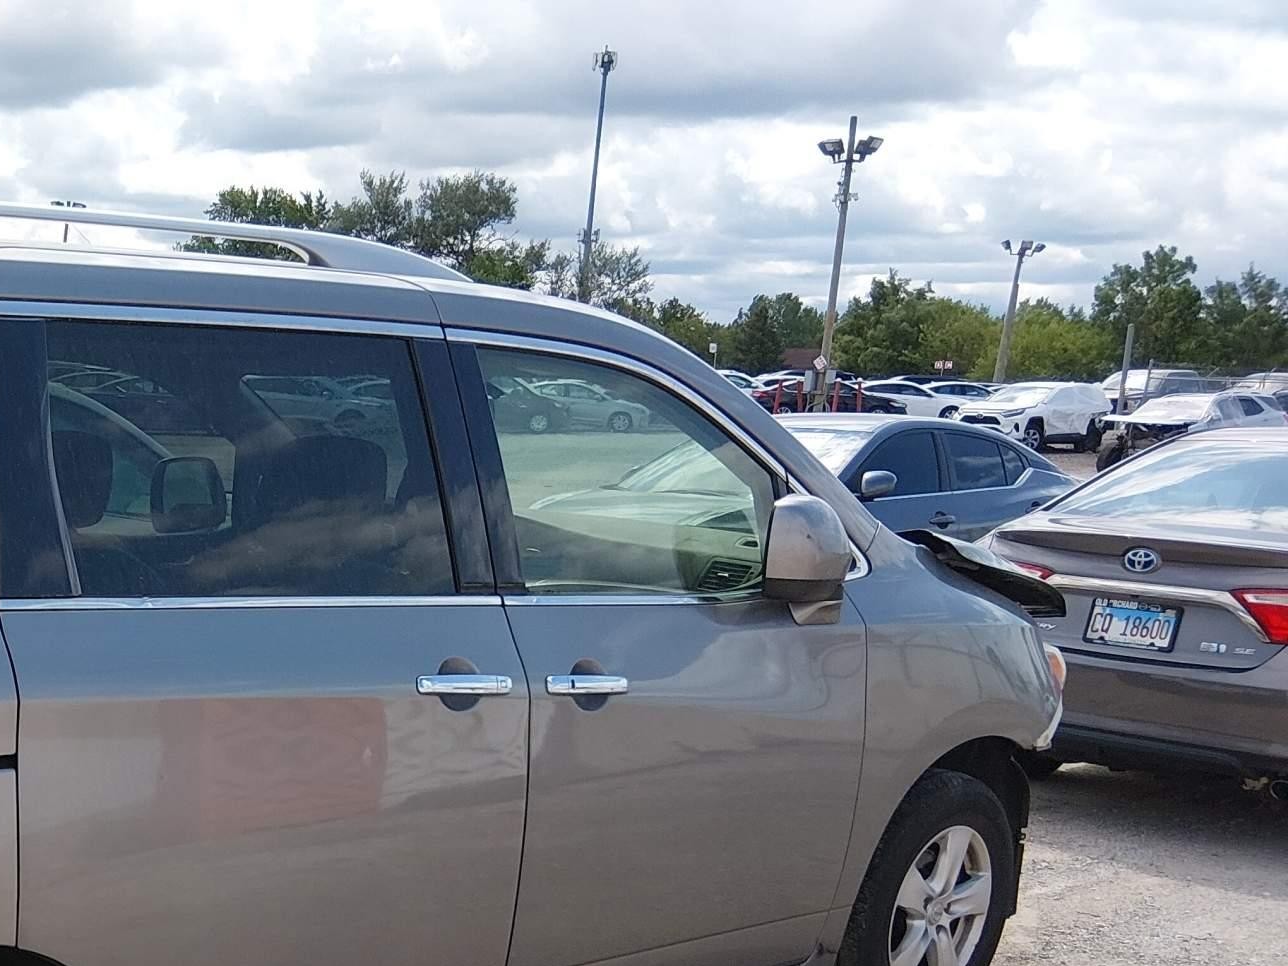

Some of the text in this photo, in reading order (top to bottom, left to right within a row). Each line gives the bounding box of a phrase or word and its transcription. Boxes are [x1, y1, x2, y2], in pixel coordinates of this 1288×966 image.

[1095, 598, 1108, 607] OLD
[1090, 612, 1171, 640] CQ 18600
[1232, 647, 1256, 656] SE
